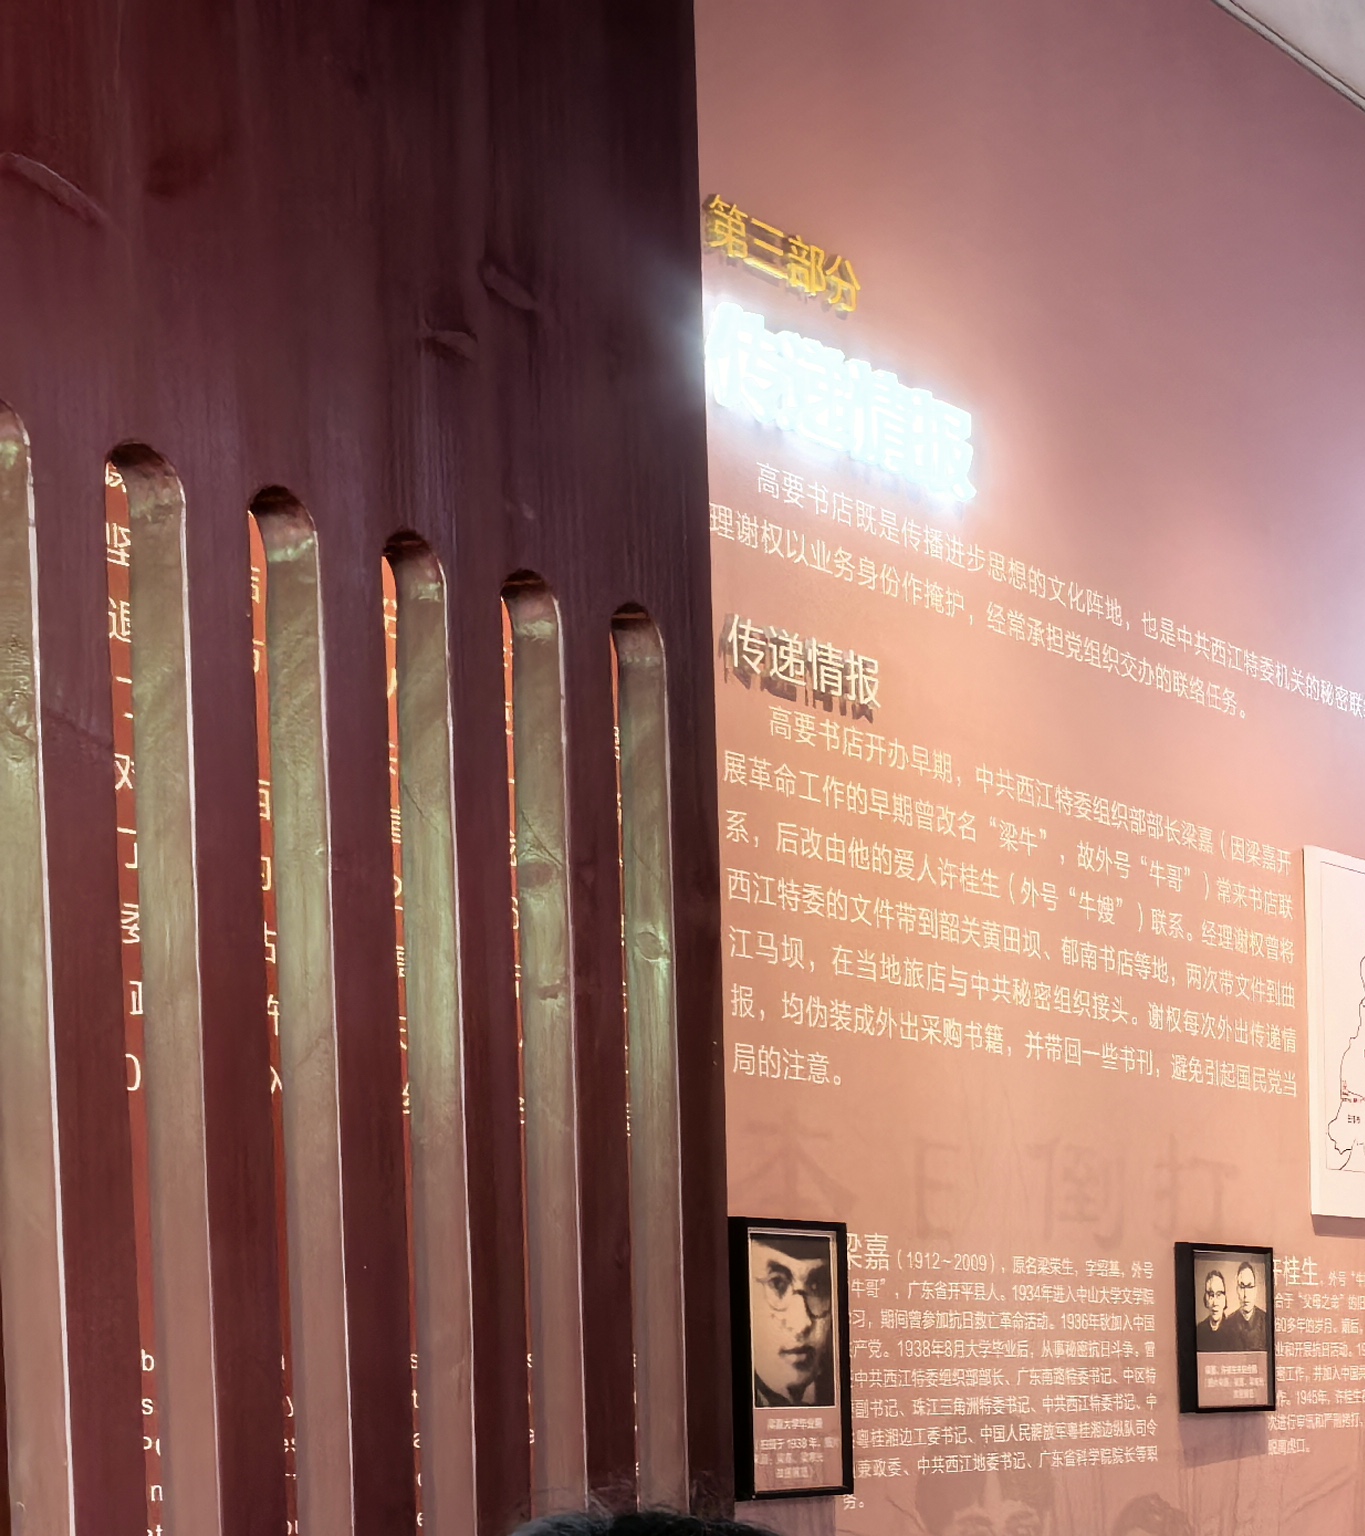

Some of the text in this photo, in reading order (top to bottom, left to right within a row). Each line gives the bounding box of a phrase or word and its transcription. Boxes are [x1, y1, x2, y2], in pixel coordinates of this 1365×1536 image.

[709, 194, 860, 312] 第三部分
[727, 614, 881, 708] 传递情报
[733, 1042, 842, 1086] 局的注意。
